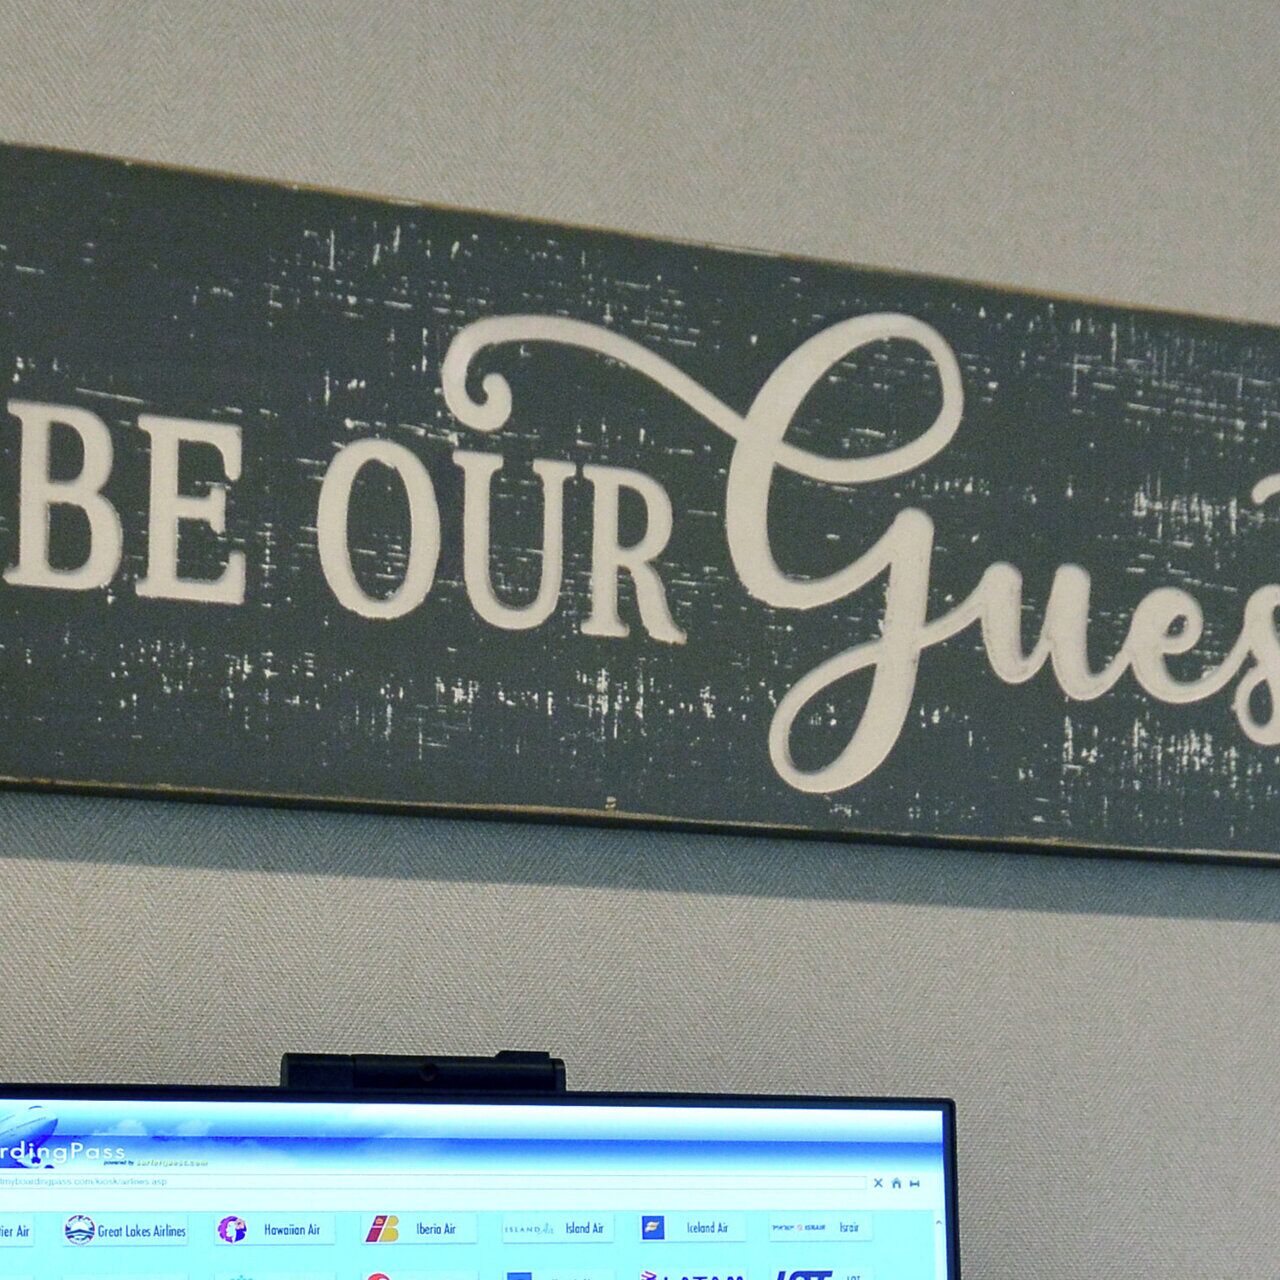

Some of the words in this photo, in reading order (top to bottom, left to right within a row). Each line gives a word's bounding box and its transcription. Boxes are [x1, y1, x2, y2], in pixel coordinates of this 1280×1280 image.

[3, 399, 246, 604] BE
[317, 438, 686, 644] OUR
[18, 1225, 30, 1237] Air
[98, 1225, 123, 1238] Great
[125, 1225, 150, 1238] Lakes
[153, 1225, 186, 1238] Airlines
[264, 1224, 305, 1236] Hawaiian
[308, 1224, 320, 1235] Air
[416, 1223, 441, 1235] Iberia
[445, 1223, 456, 1234] Air
[566, 1223, 592, 1234] Island
[594, 1223, 604, 1233] Air
[687, 1223, 715, 1233] Iceland
[718, 1223, 729, 1233] Air
[839, 1221, 859, 1233] Israir
